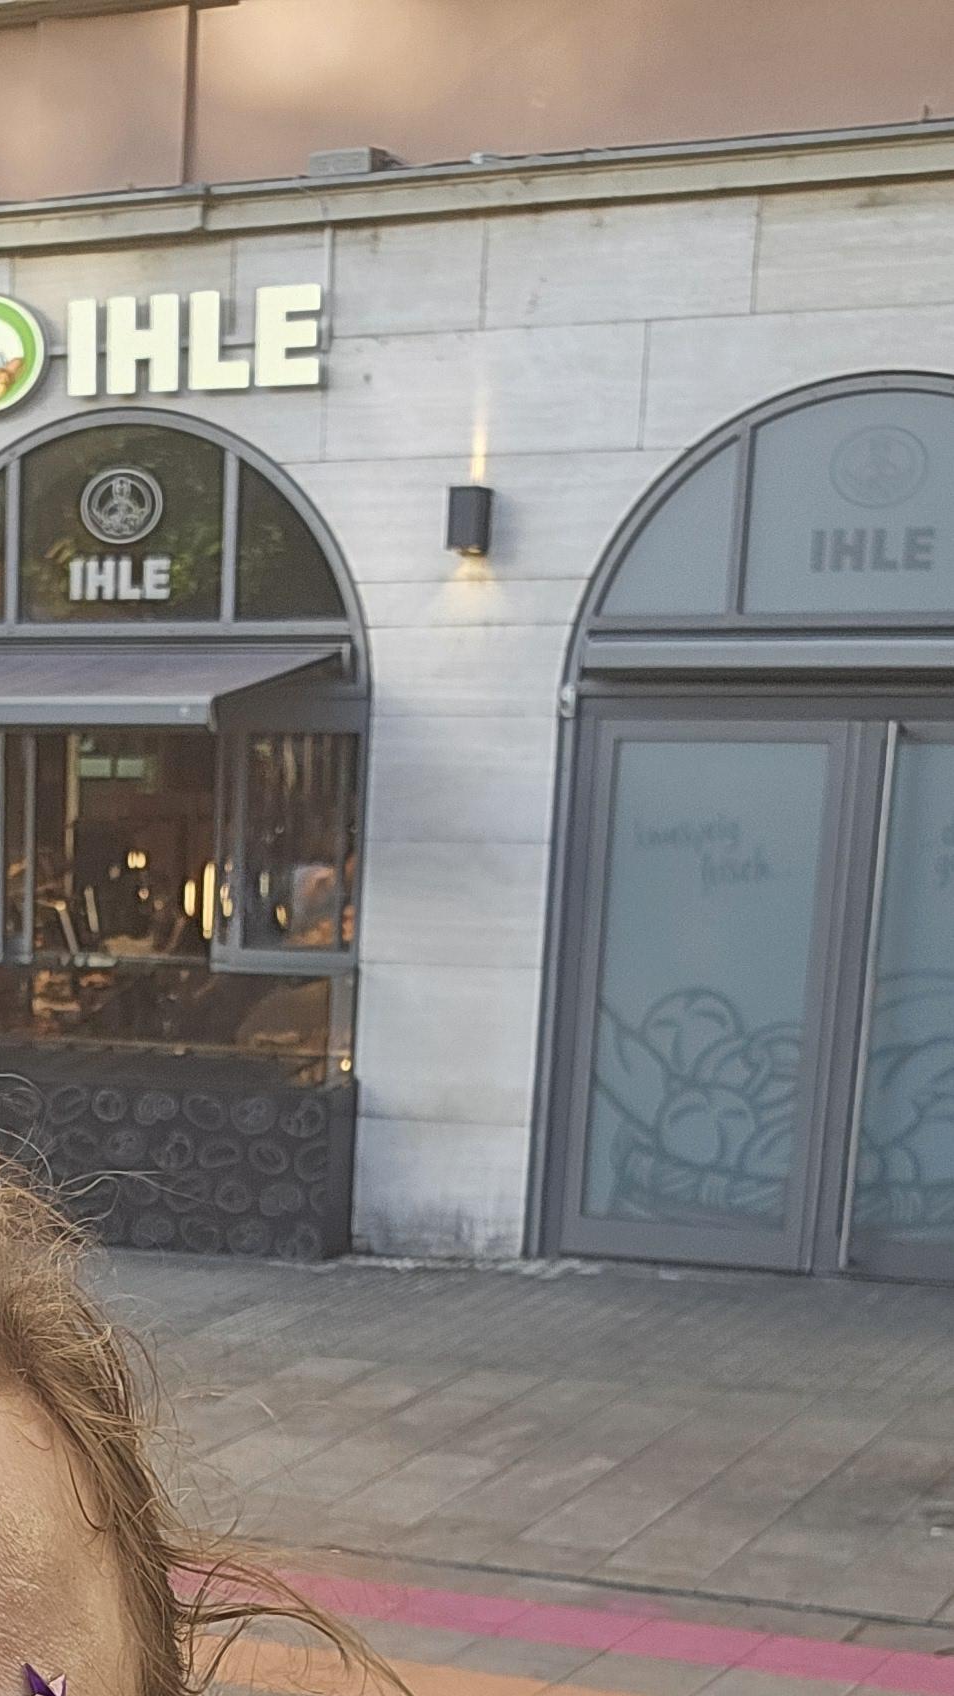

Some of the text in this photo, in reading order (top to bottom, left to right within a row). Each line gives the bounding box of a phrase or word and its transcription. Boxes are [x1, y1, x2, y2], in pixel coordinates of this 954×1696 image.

[67, 283, 321, 396] IHLE
[810, 526, 935, 573] IHLE
[68, 556, 172, 600] IHLE
